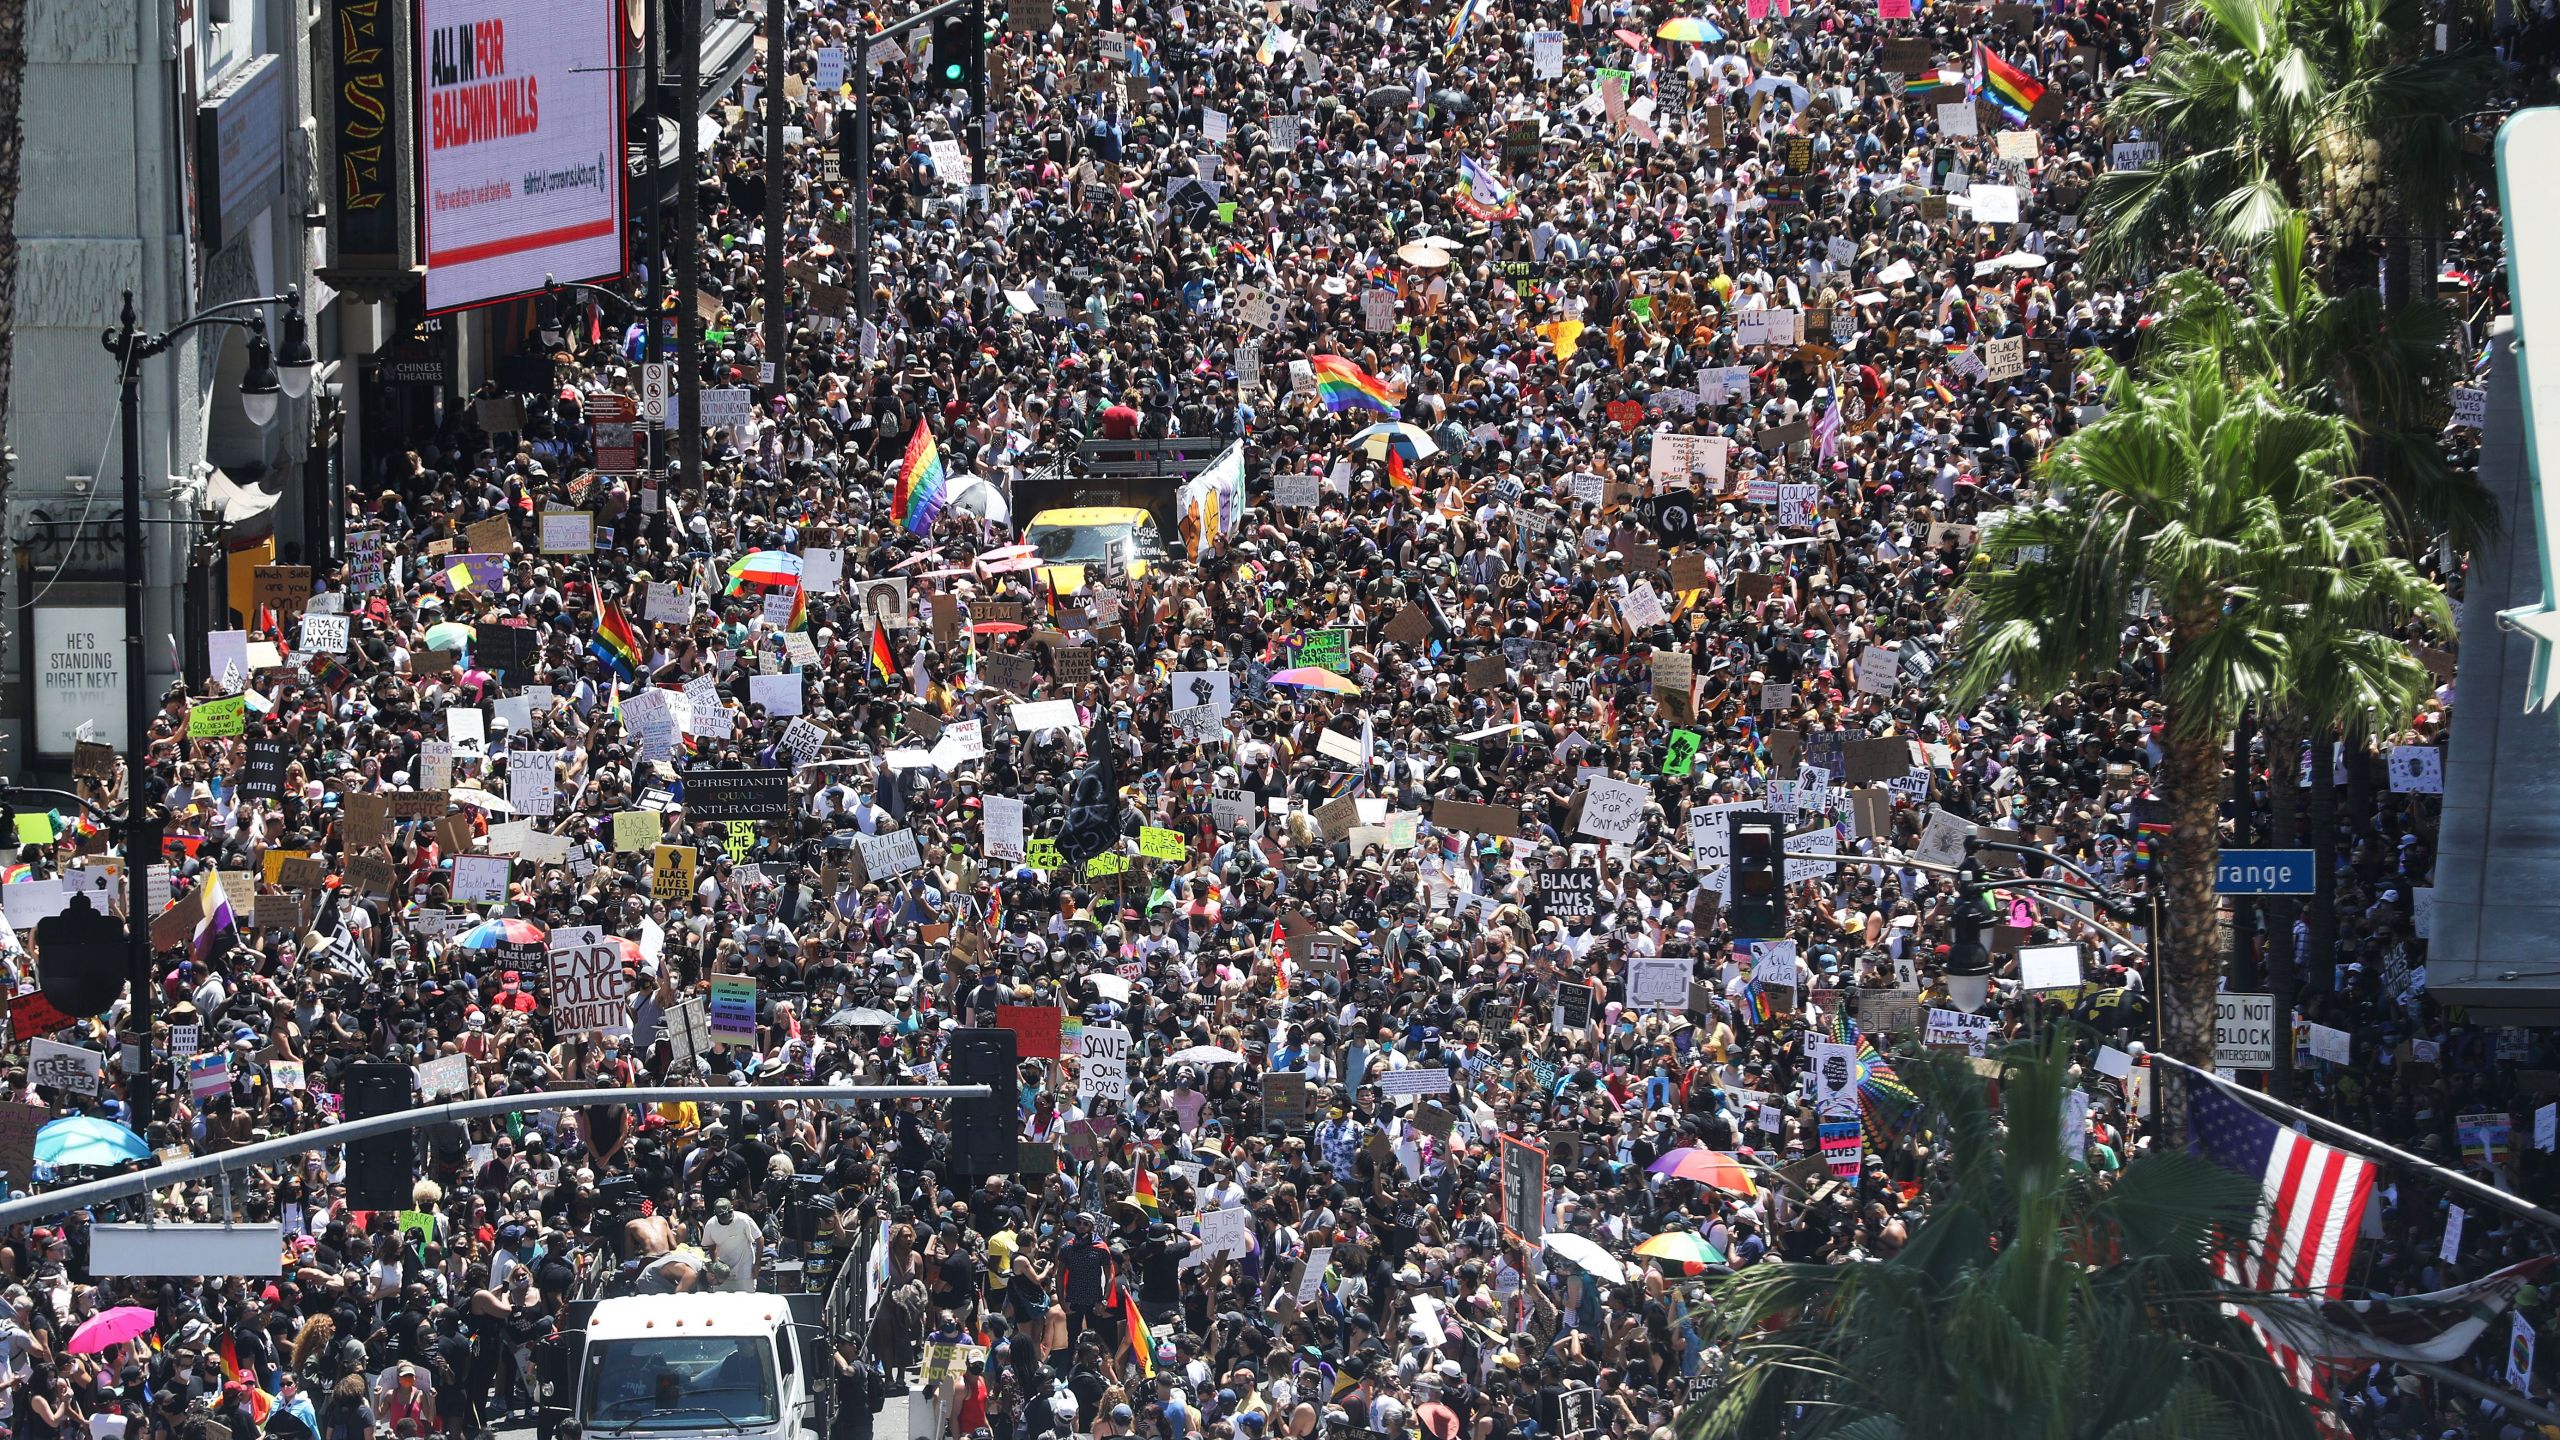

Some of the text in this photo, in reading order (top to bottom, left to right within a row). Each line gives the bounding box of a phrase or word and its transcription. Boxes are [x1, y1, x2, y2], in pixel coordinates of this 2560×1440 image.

[1100, 39, 1123, 53] JUSTICE
[432, 19, 504, 88] ALL IN FOR
[1601, 71, 1626, 80] RACISM
[432, 76, 538, 150] BALDWIN HILLS
[1269, 118, 1300, 129] BLACK
[1269, 129, 1301, 139] LIVES
[1268, 139, 1299, 149] MATTER
[2117, 152, 2131, 161] ALL
[424, 318, 442, 333] TCL
[1738, 314, 1765, 327] ALL
[1831, 316, 1856, 324] BLACK
[1990, 340, 2021, 355] BLACK
[1993, 353, 2018, 365] LIVES
[396, 363, 442, 373] CHINESE
[1989, 363, 2023, 376] MATTER
[396, 373, 442, 381] THEATRES
[1496, 480, 1521, 497] BLM
[1781, 487, 1817, 500] COLOR
[1779, 514, 1814, 527] CRIME
[1131, 527, 1159, 538] JUSTICE
[1907, 521, 1930, 538] BLM
[350, 552, 381, 564] TRANS
[254, 570, 283, 579] Which
[1498, 574, 1520, 588] BLM
[266, 584, 308, 594] are you
[1096, 592, 1116, 600] BLACK
[973, 607, 1012, 620] BLM
[308, 617, 345, 629] BLACK
[306, 629, 342, 638] LIVES
[66, 633, 95, 649] HE'S
[304, 638, 345, 649] MATTER
[51, 653, 112, 669] STANDING
[1060, 651, 1089, 659] BLACK
[995, 655, 1025, 669] LOVE
[1060, 660, 1090, 668] TRANS
[1003, 669, 1013, 677] IS
[1060, 668, 1089, 676] LIVES
[46, 672, 118, 689] RIGHT NEXT
[992, 676, 1020, 689] LOVE
[1056, 677, 1090, 685] MATTER
[197, 705, 223, 715] JESUS
[693, 707, 731, 719] NO MORE
[693, 728, 716, 736] COPS
[800, 723, 816, 736] ALL
[955, 723, 975, 733] HATE
[790, 727, 820, 746] BLACK
[957, 734, 974, 742] WILL
[1818, 732, 1863, 743] MAY NEVER
[254, 743, 280, 754] BLACK
[785, 734, 816, 755] LIVES
[252, 762, 275, 772] LIVES
[512, 754, 552, 769] BLACK
[513, 770, 551, 784] TRANS
[1909, 772, 1929, 780] LIVES
[246, 782, 277, 793] MATTER
[687, 778, 786, 788] CHRISTIANITY
[1889, 778, 1926, 793] CANT
[1591, 791, 1634, 807] JUSTICE
[394, 802, 443, 816] RIGHTS
[512, 800, 552, 813] MATTER
[689, 804, 788, 815] ANTI-RACISM
[1602, 805, 1621, 813] FOR
[617, 819, 646, 828] BLACK
[1584, 809, 1641, 832] TONY McDADE
[625, 827, 650, 836] LIVES
[861, 829, 912, 855] PROTECT
[991, 842, 1018, 851] POLICE
[865, 843, 917, 872] BLACK TRANS
[659, 870, 687, 879] BLACK
[880, 863, 909, 877] KIDS
[657, 880, 688, 888] LIVES
[1541, 873, 1594, 890] BLACK
[2217, 866, 2292, 890] range
[654, 888, 690, 897] MATTER
[1551, 891, 1595, 907] LIVES
[1544, 905, 1598, 916] MATTER
[510, 943, 526, 951] LET
[497, 950, 542, 961] BLACK LIVES
[503, 960, 534, 970] THRIVE
[549, 947, 617, 980] END
[551, 970, 624, 1009] POLICE
[1566, 987, 1583, 995] END
[553, 1002, 626, 1033] BRUTALITY
[2216, 1004, 2271, 1020] DO NOT
[1957, 1014, 1987, 1030] BLACK
[2216, 1029, 2271, 1045] BLOCK
[1082, 1035, 1126, 1061] SAVE
[1474, 1051, 1504, 1072] BLACK
[1525, 1053, 1552, 1070] BLACK
[2216, 1050, 2271, 1061] INTERSECTION
[35, 1060, 77, 1077] FREE
[1091, 1065, 1123, 1080] OUR
[43, 1075, 96, 1089] WATER
[1083, 1079, 1119, 1094] BOYS
[1823, 1131, 1859, 1143] BLACK
[1824, 1147, 1857, 1158] LIVES
[934, 1345, 956, 1359] SEE
[1689, 1379, 1718, 1391] BLACK
